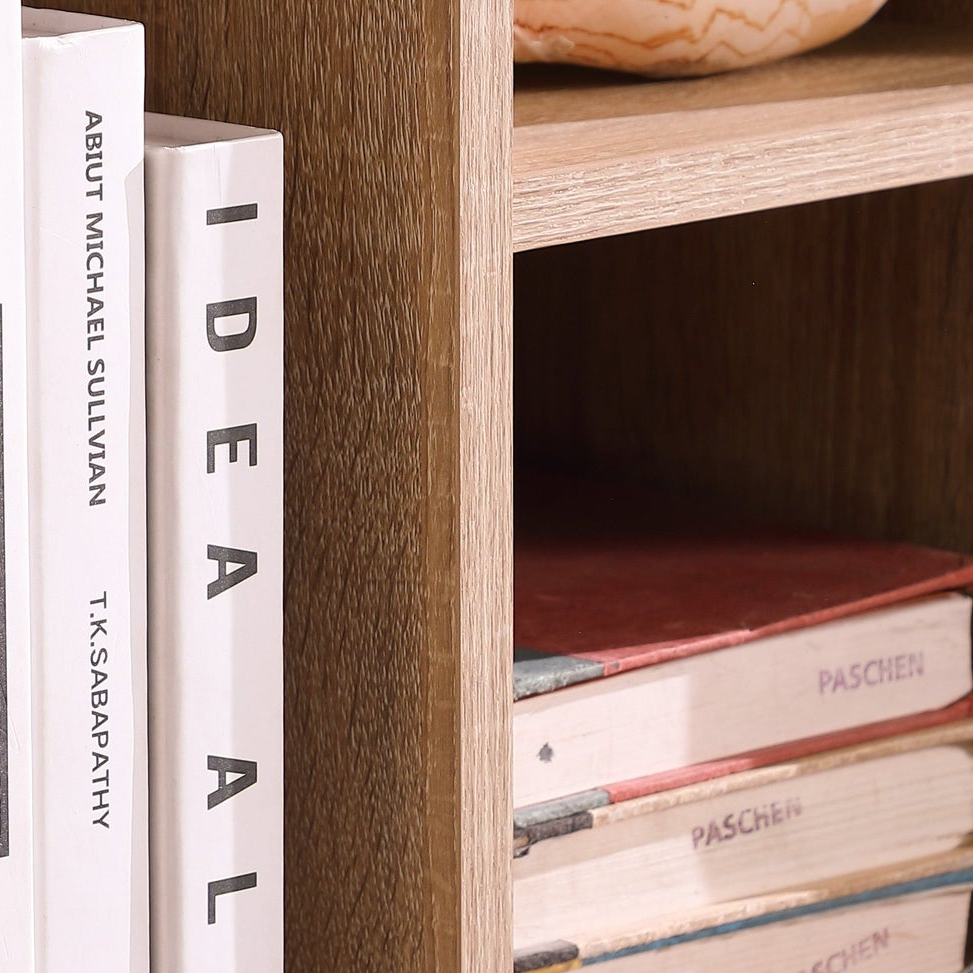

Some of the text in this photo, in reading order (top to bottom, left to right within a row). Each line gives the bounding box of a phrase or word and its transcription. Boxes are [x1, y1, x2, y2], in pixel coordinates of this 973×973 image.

[85, 110, 106, 507] ABIUT MICHAEL SULLVIAN
[89, 591, 109, 829] T.K.SABAPATHY
[819, 650, 926, 696] PASCHEN
[692, 797, 803, 850] PASCHEN
